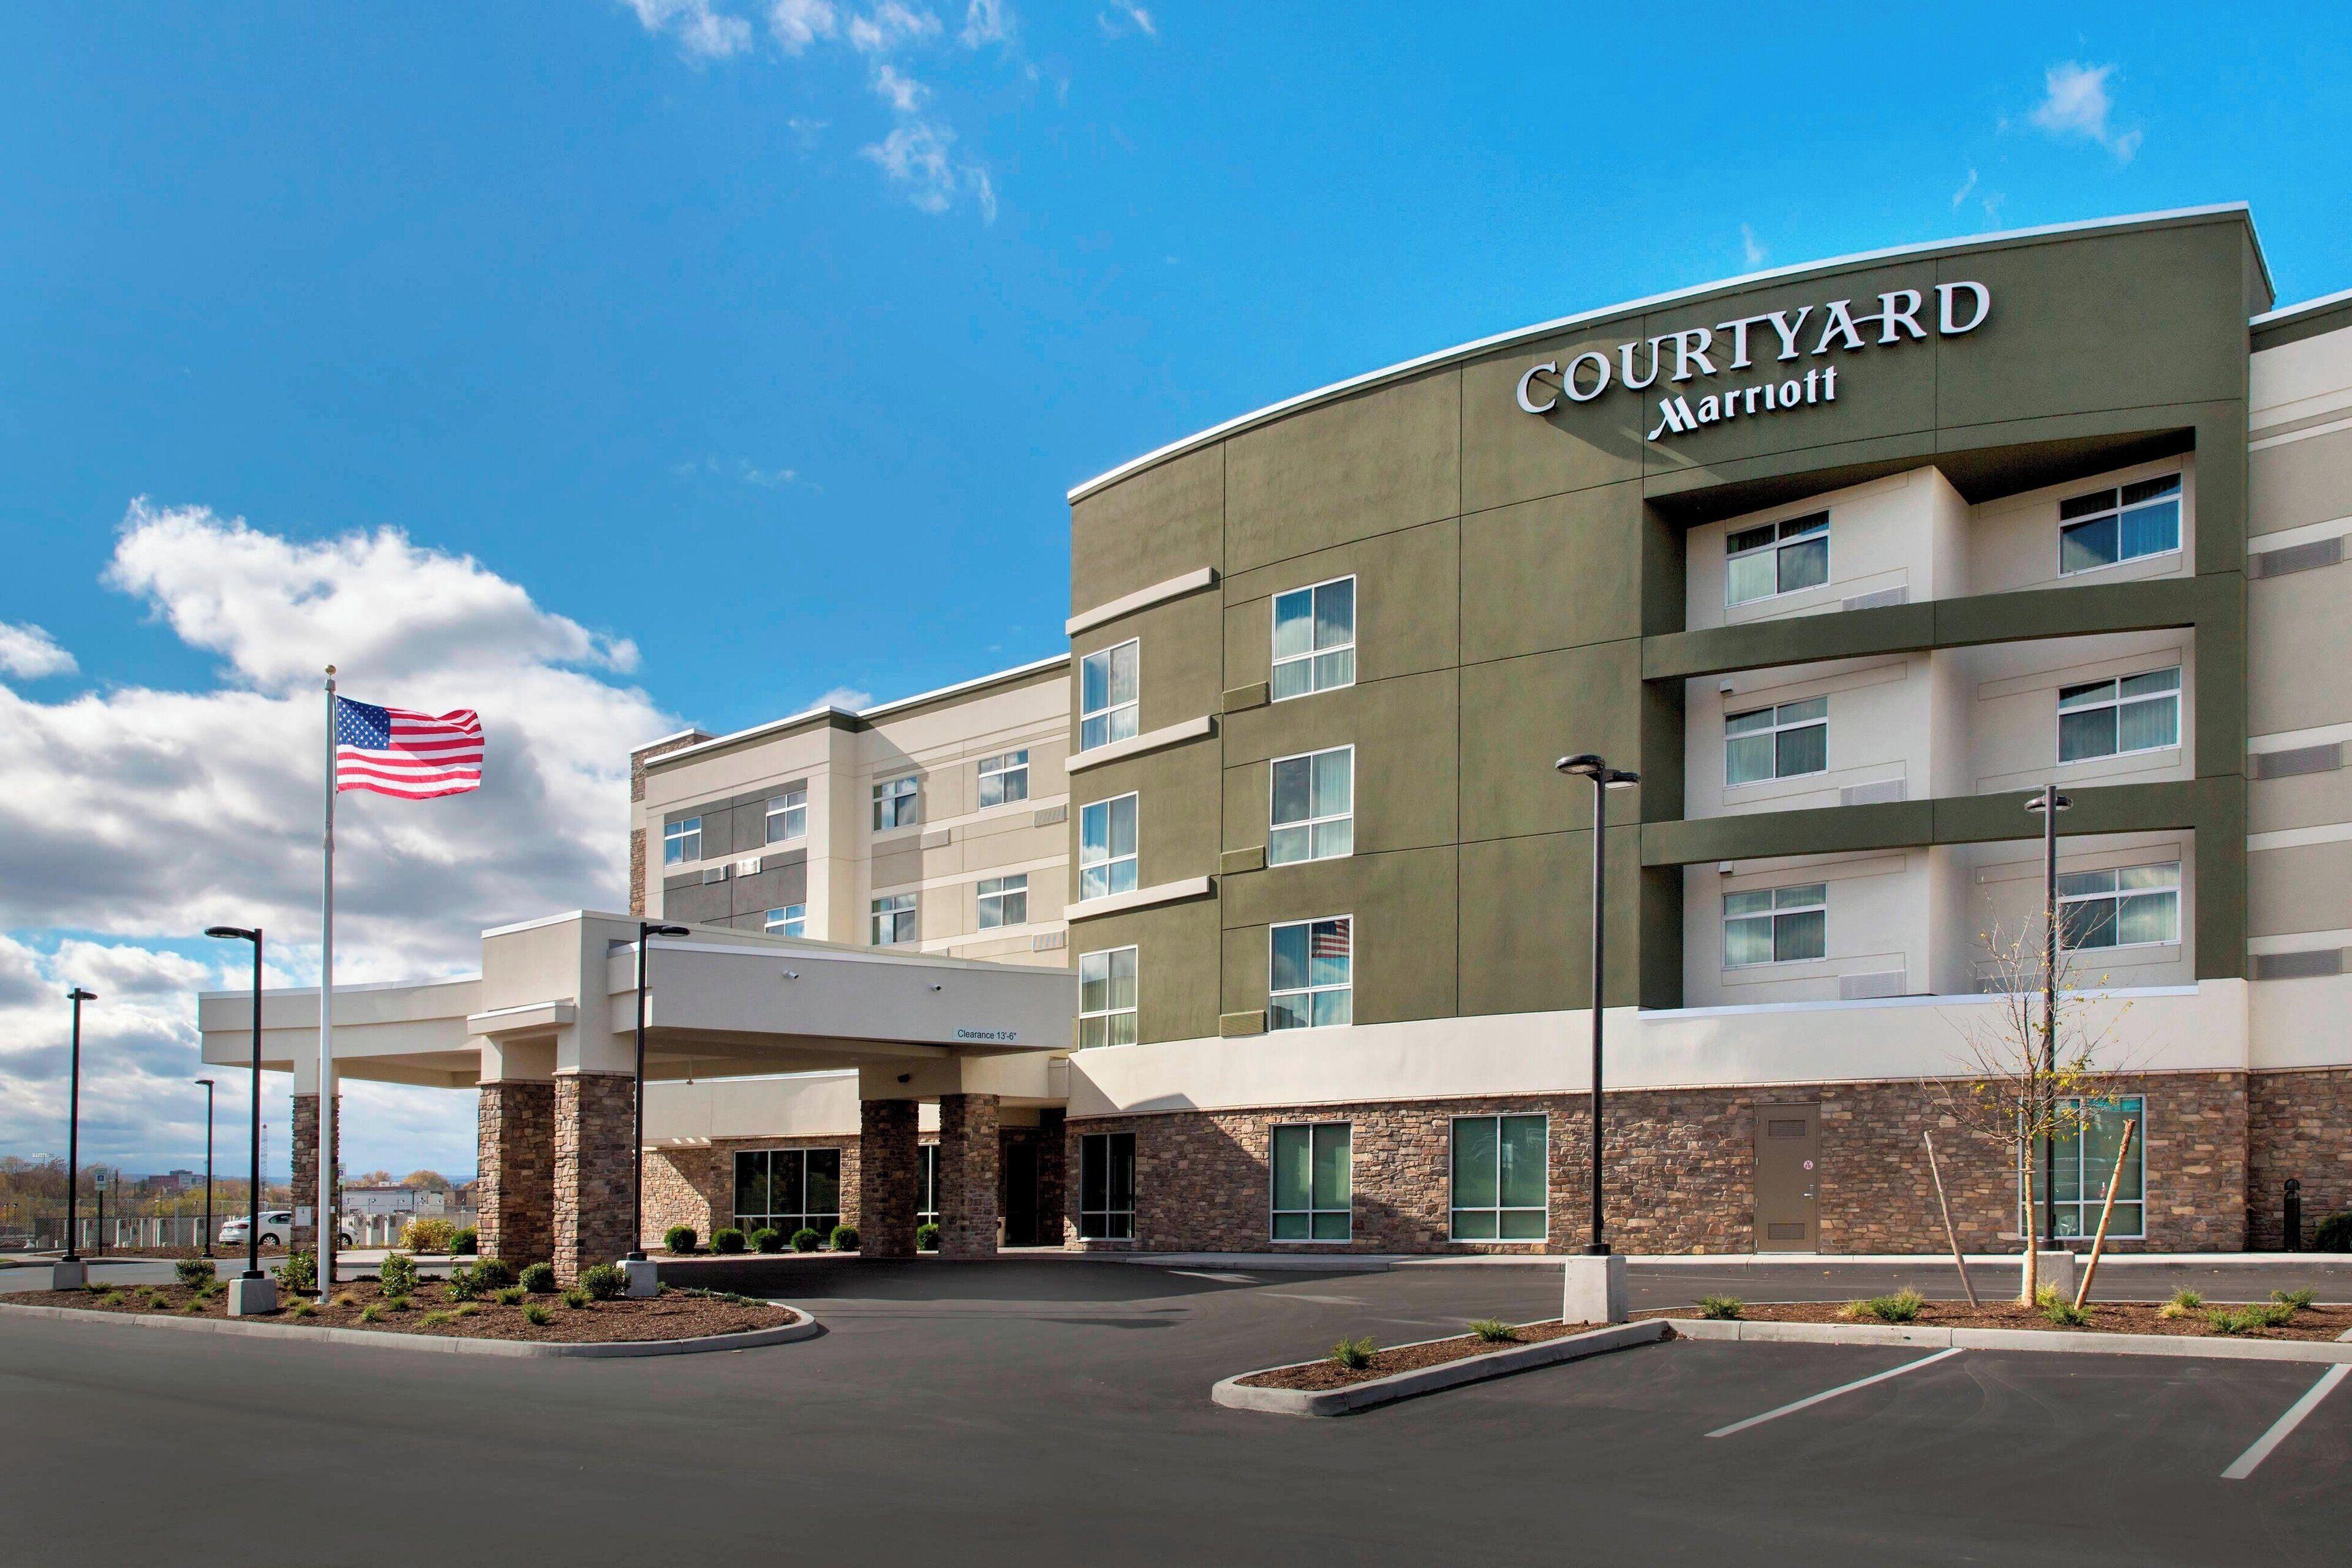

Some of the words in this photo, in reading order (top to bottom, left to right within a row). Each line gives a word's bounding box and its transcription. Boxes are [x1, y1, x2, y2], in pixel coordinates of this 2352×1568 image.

[1517, 281, 1990, 414] COURTYARD
[1647, 366, 1838, 441] Marriott
[958, 1030, 994, 1039] Clearance
[997, 1031, 1017, 1040] 13'-6"
